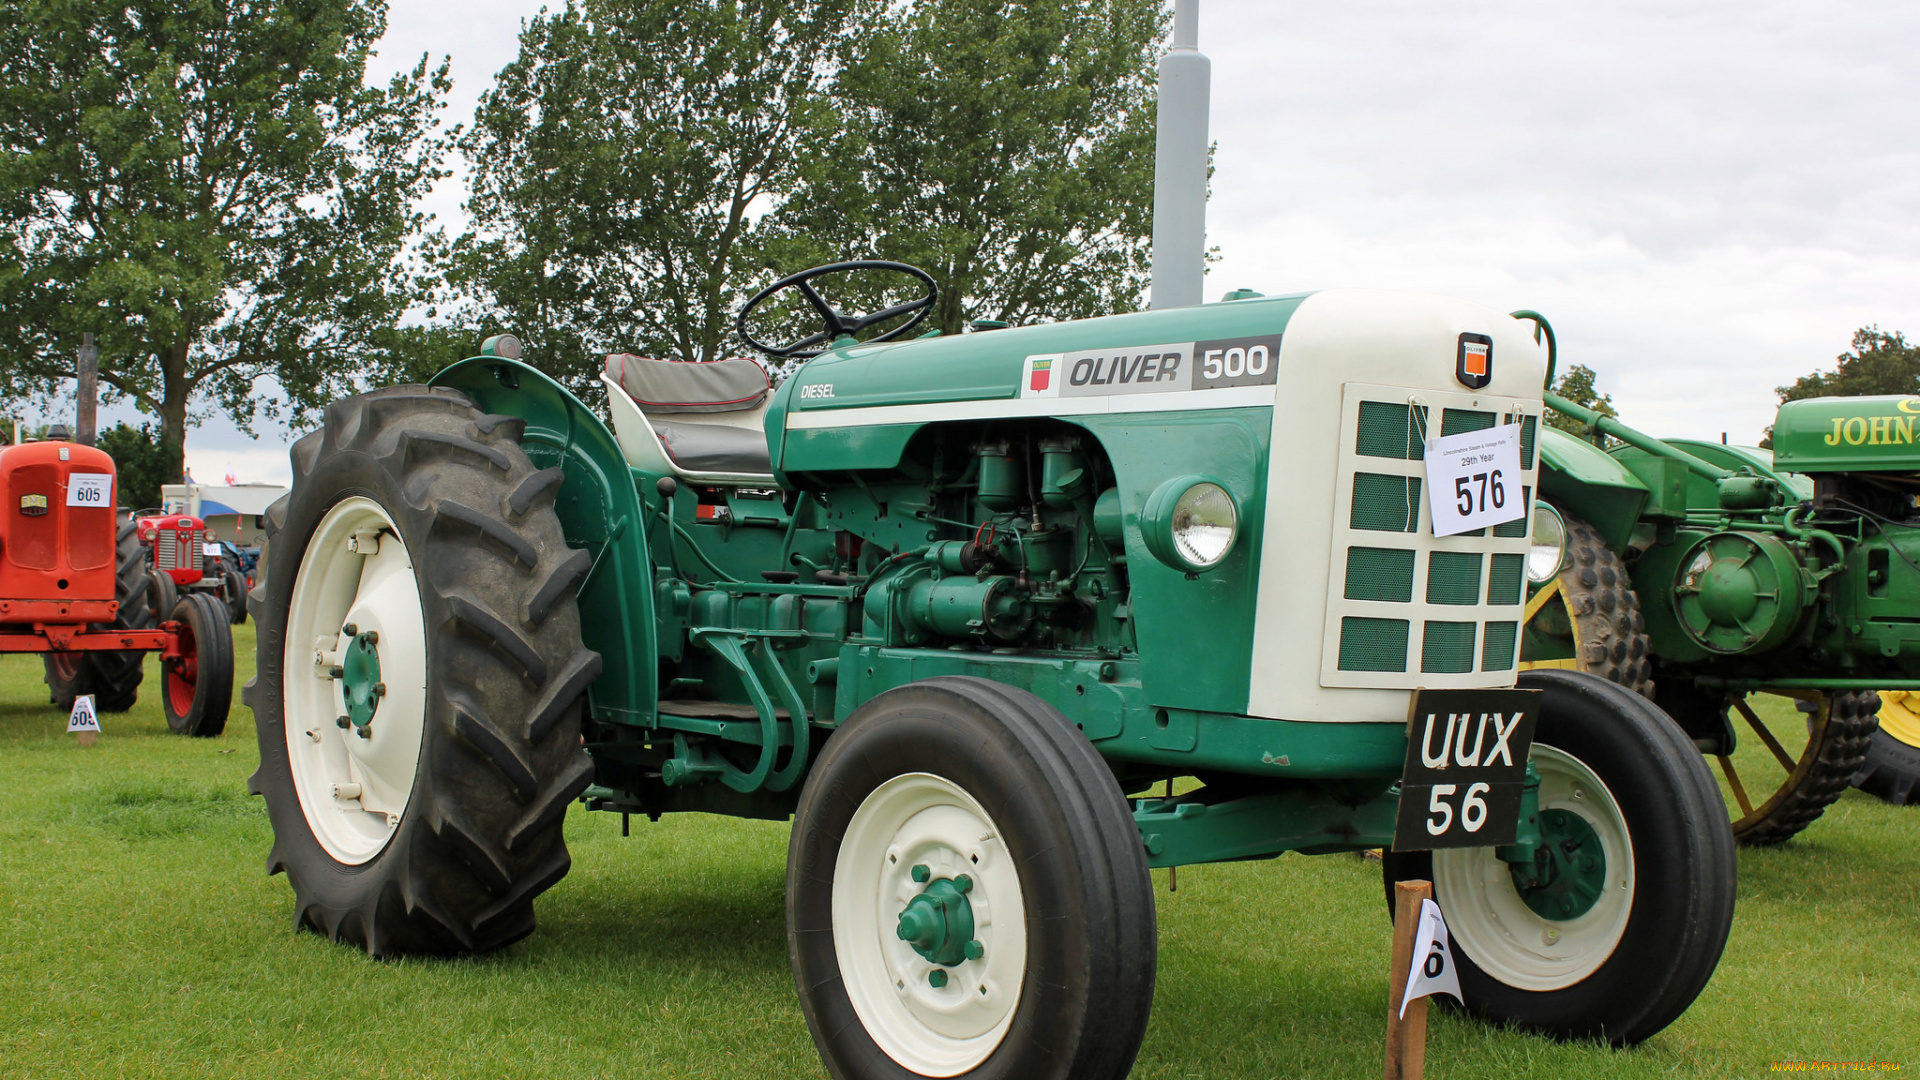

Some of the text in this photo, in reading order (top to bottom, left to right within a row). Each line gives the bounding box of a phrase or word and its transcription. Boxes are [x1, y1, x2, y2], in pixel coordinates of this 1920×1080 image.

[1069, 345, 1269, 387] OLIVER 500
[800, 383, 836, 399] DIESEL
[1824, 415, 1917, 446] JOHN
[1461, 454, 1495, 467] 29th Year
[77, 487, 101, 502] 605
[1455, 469, 1505, 517] 576
[1421, 712, 1524, 769] UUX
[1427, 782, 1491, 836] 56
